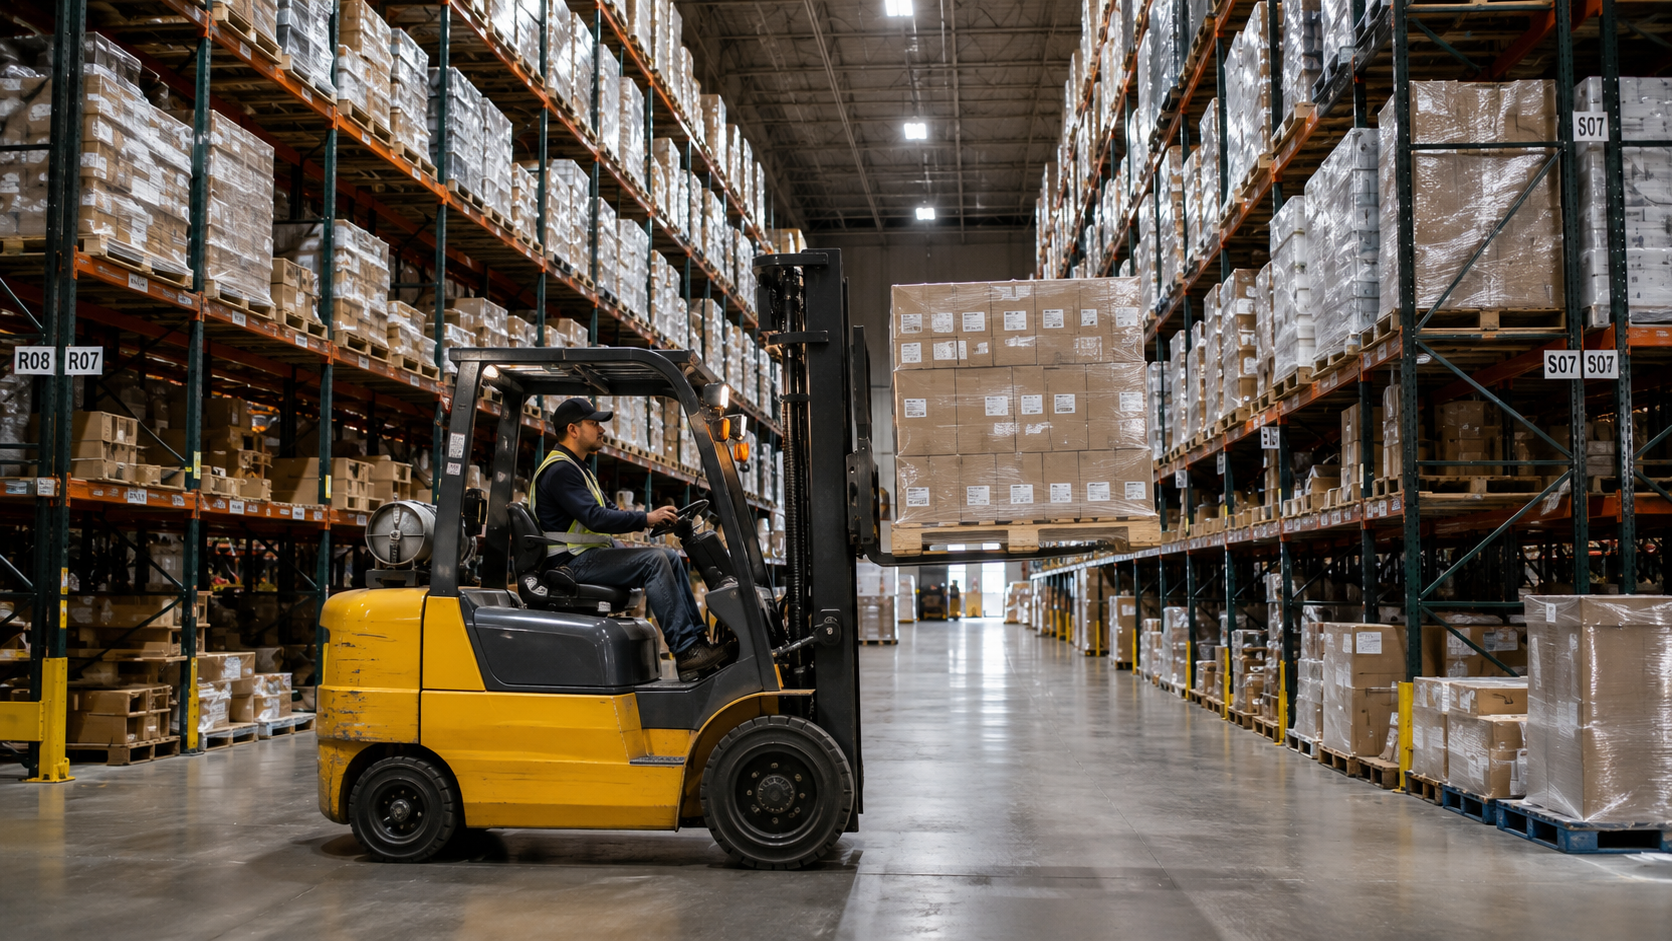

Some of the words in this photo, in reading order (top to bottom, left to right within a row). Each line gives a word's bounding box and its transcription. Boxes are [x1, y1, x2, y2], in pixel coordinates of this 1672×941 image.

[1578, 116, 1605, 137] S07
[18, 352, 50, 370] R08
[68, 352, 99, 370] R07
[1548, 354, 1577, 374] S07
[1587, 354, 1614, 374] S07
